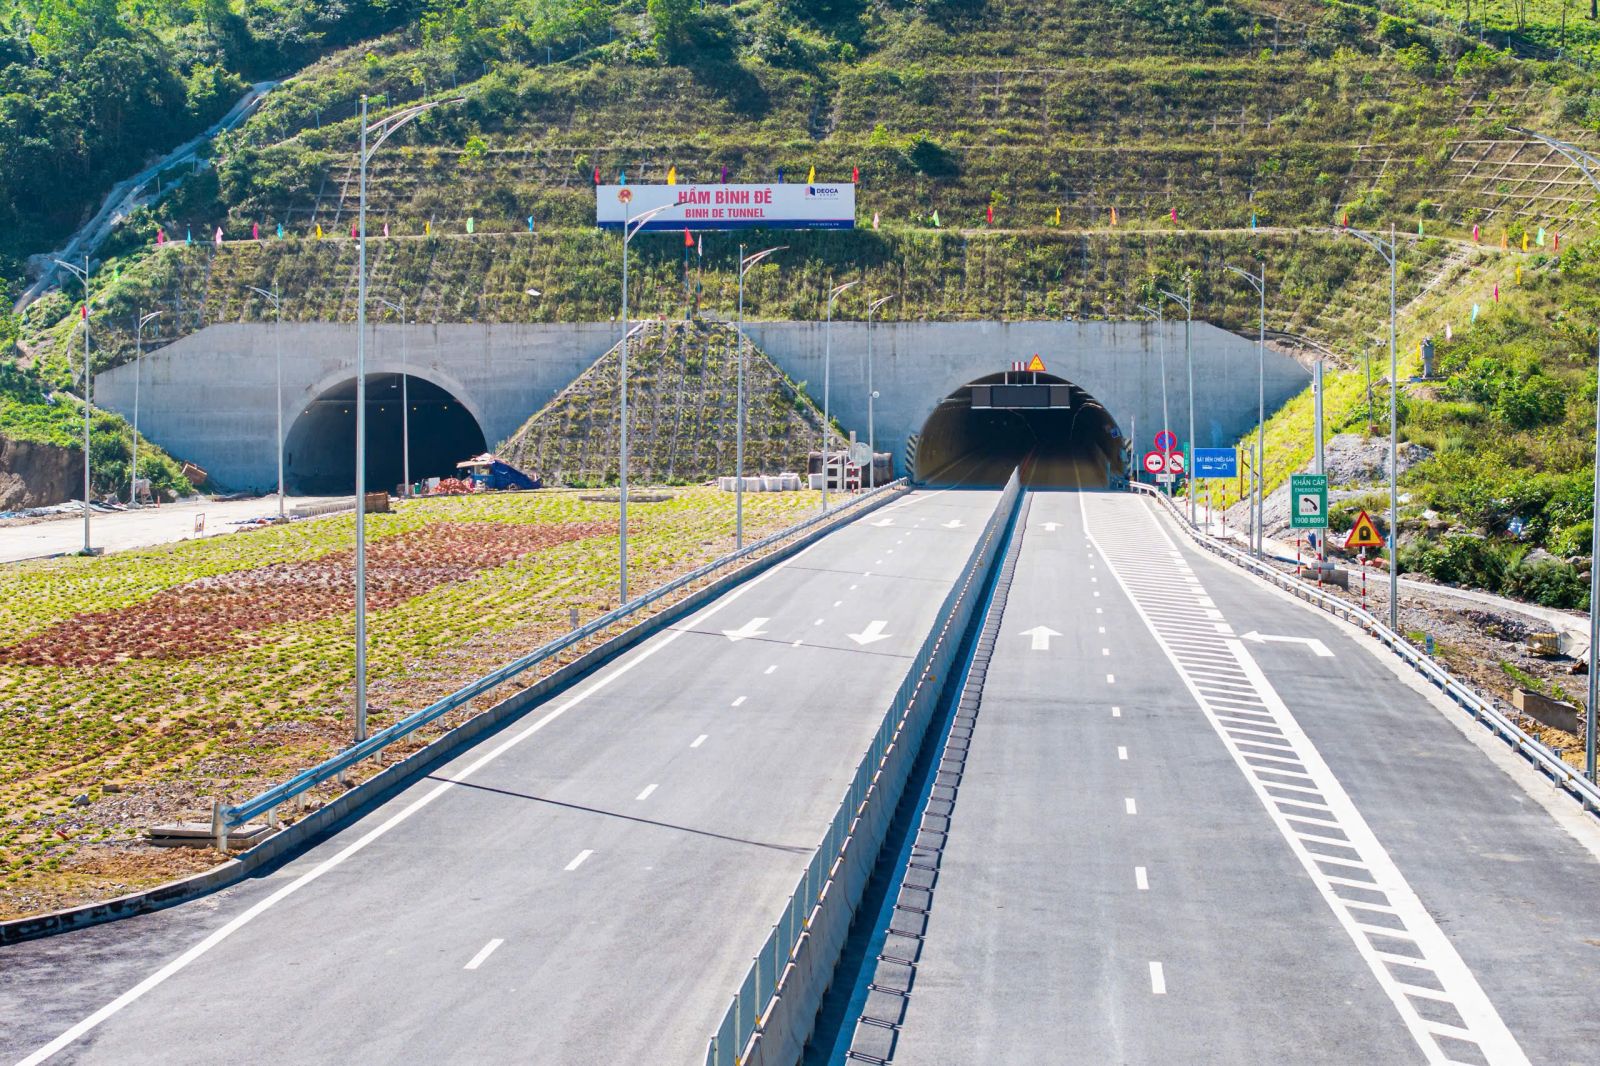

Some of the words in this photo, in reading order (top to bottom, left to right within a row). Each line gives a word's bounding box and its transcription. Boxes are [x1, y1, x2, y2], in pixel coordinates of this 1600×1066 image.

[678, 187, 710, 204] HẦM
[715, 187, 749, 204] BÌNH
[685, 208, 709, 218] BINH
[712, 208, 724, 218] DE
[728, 208, 765, 218] TUNNEL
